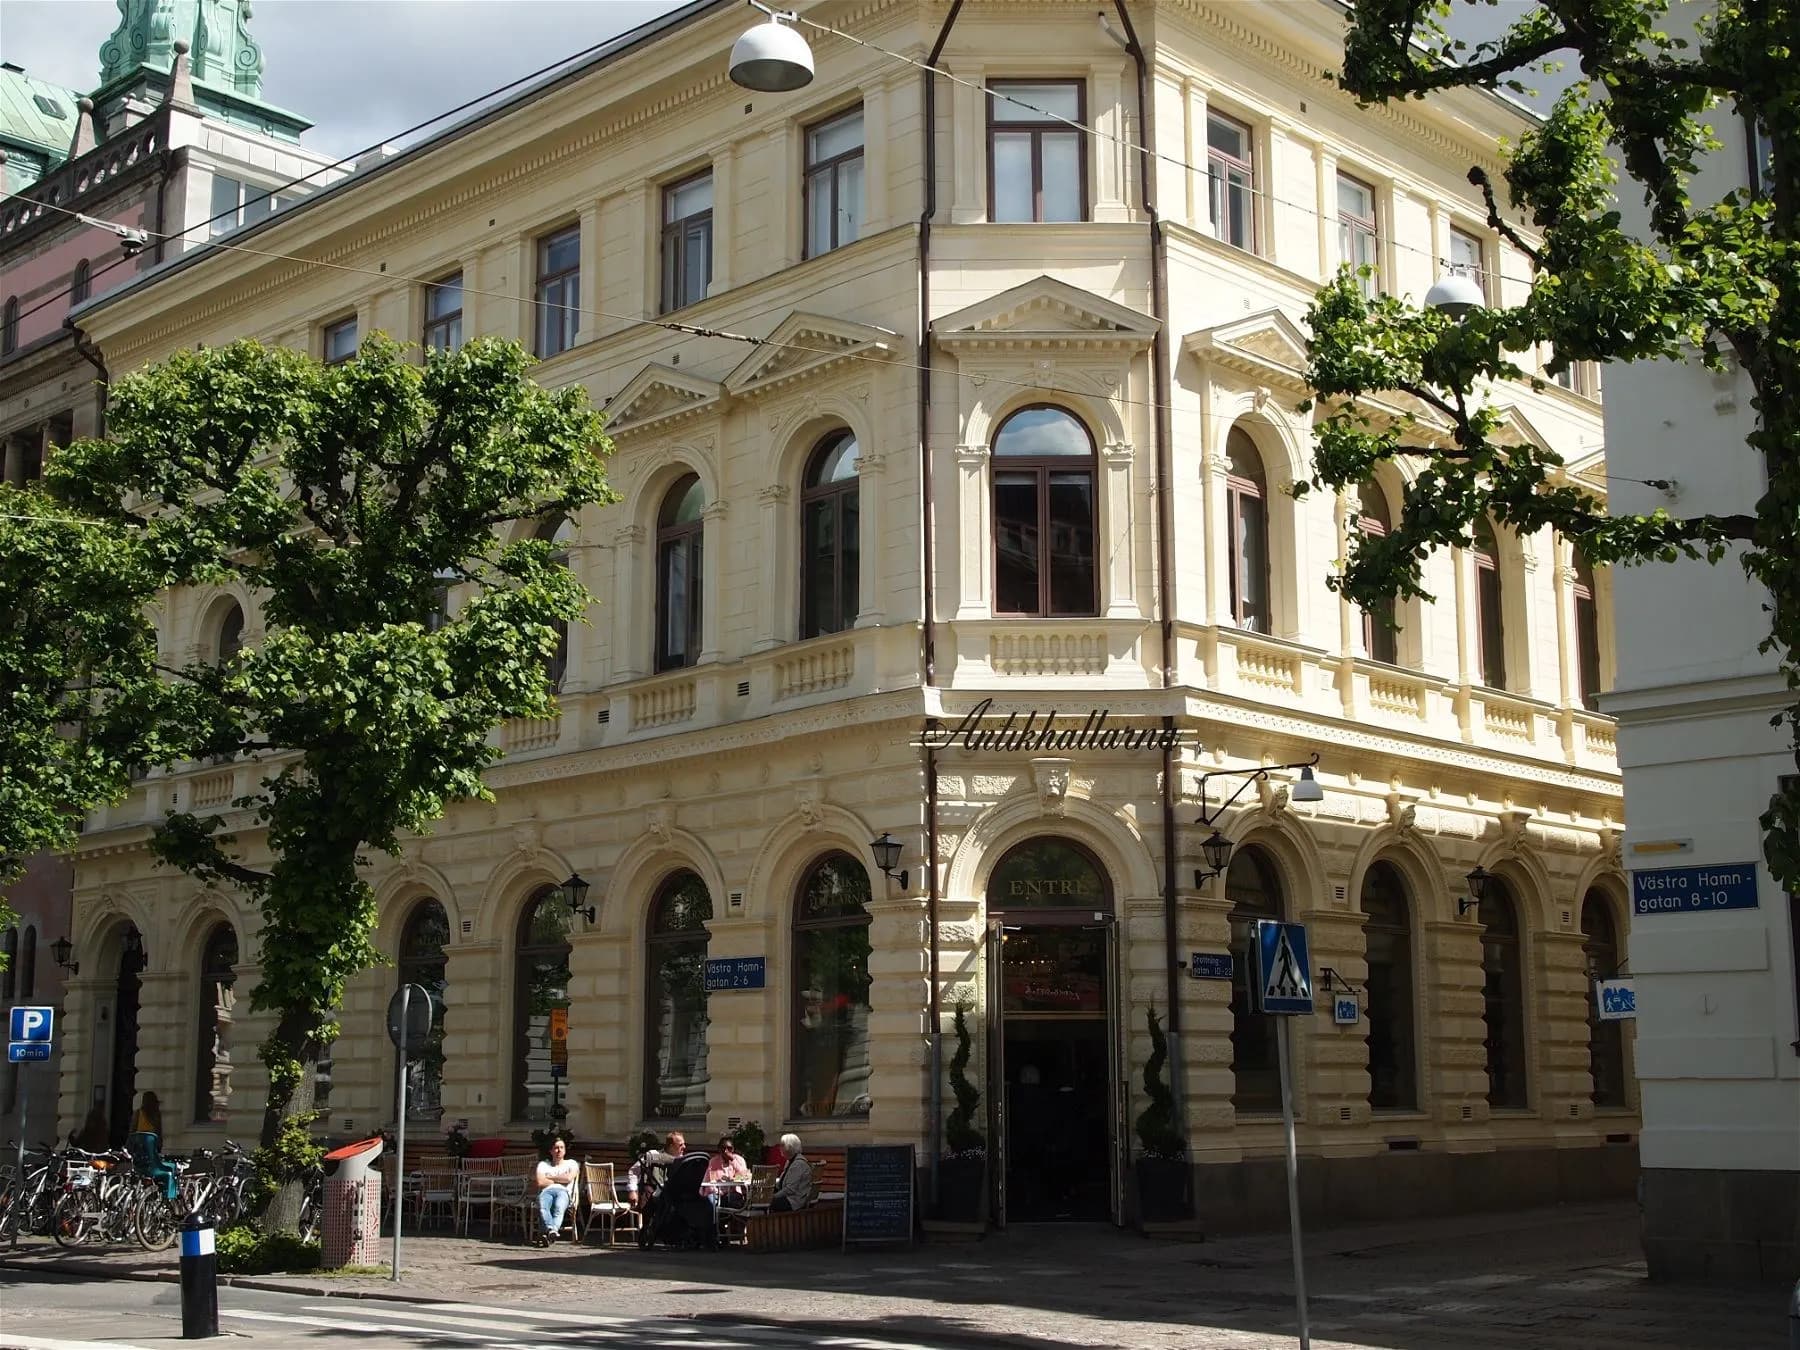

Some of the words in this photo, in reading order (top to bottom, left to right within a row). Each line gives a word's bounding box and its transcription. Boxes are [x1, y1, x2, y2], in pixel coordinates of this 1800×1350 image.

[922, 698, 1181, 751] Antikhallarna
[1638, 875, 1688, 891] Västra
[1640, 895, 1682, 912] gatan
[707, 963, 731, 974] Västra
[707, 977, 729, 990] gatan
[22, 1010, 43, 1039] P
